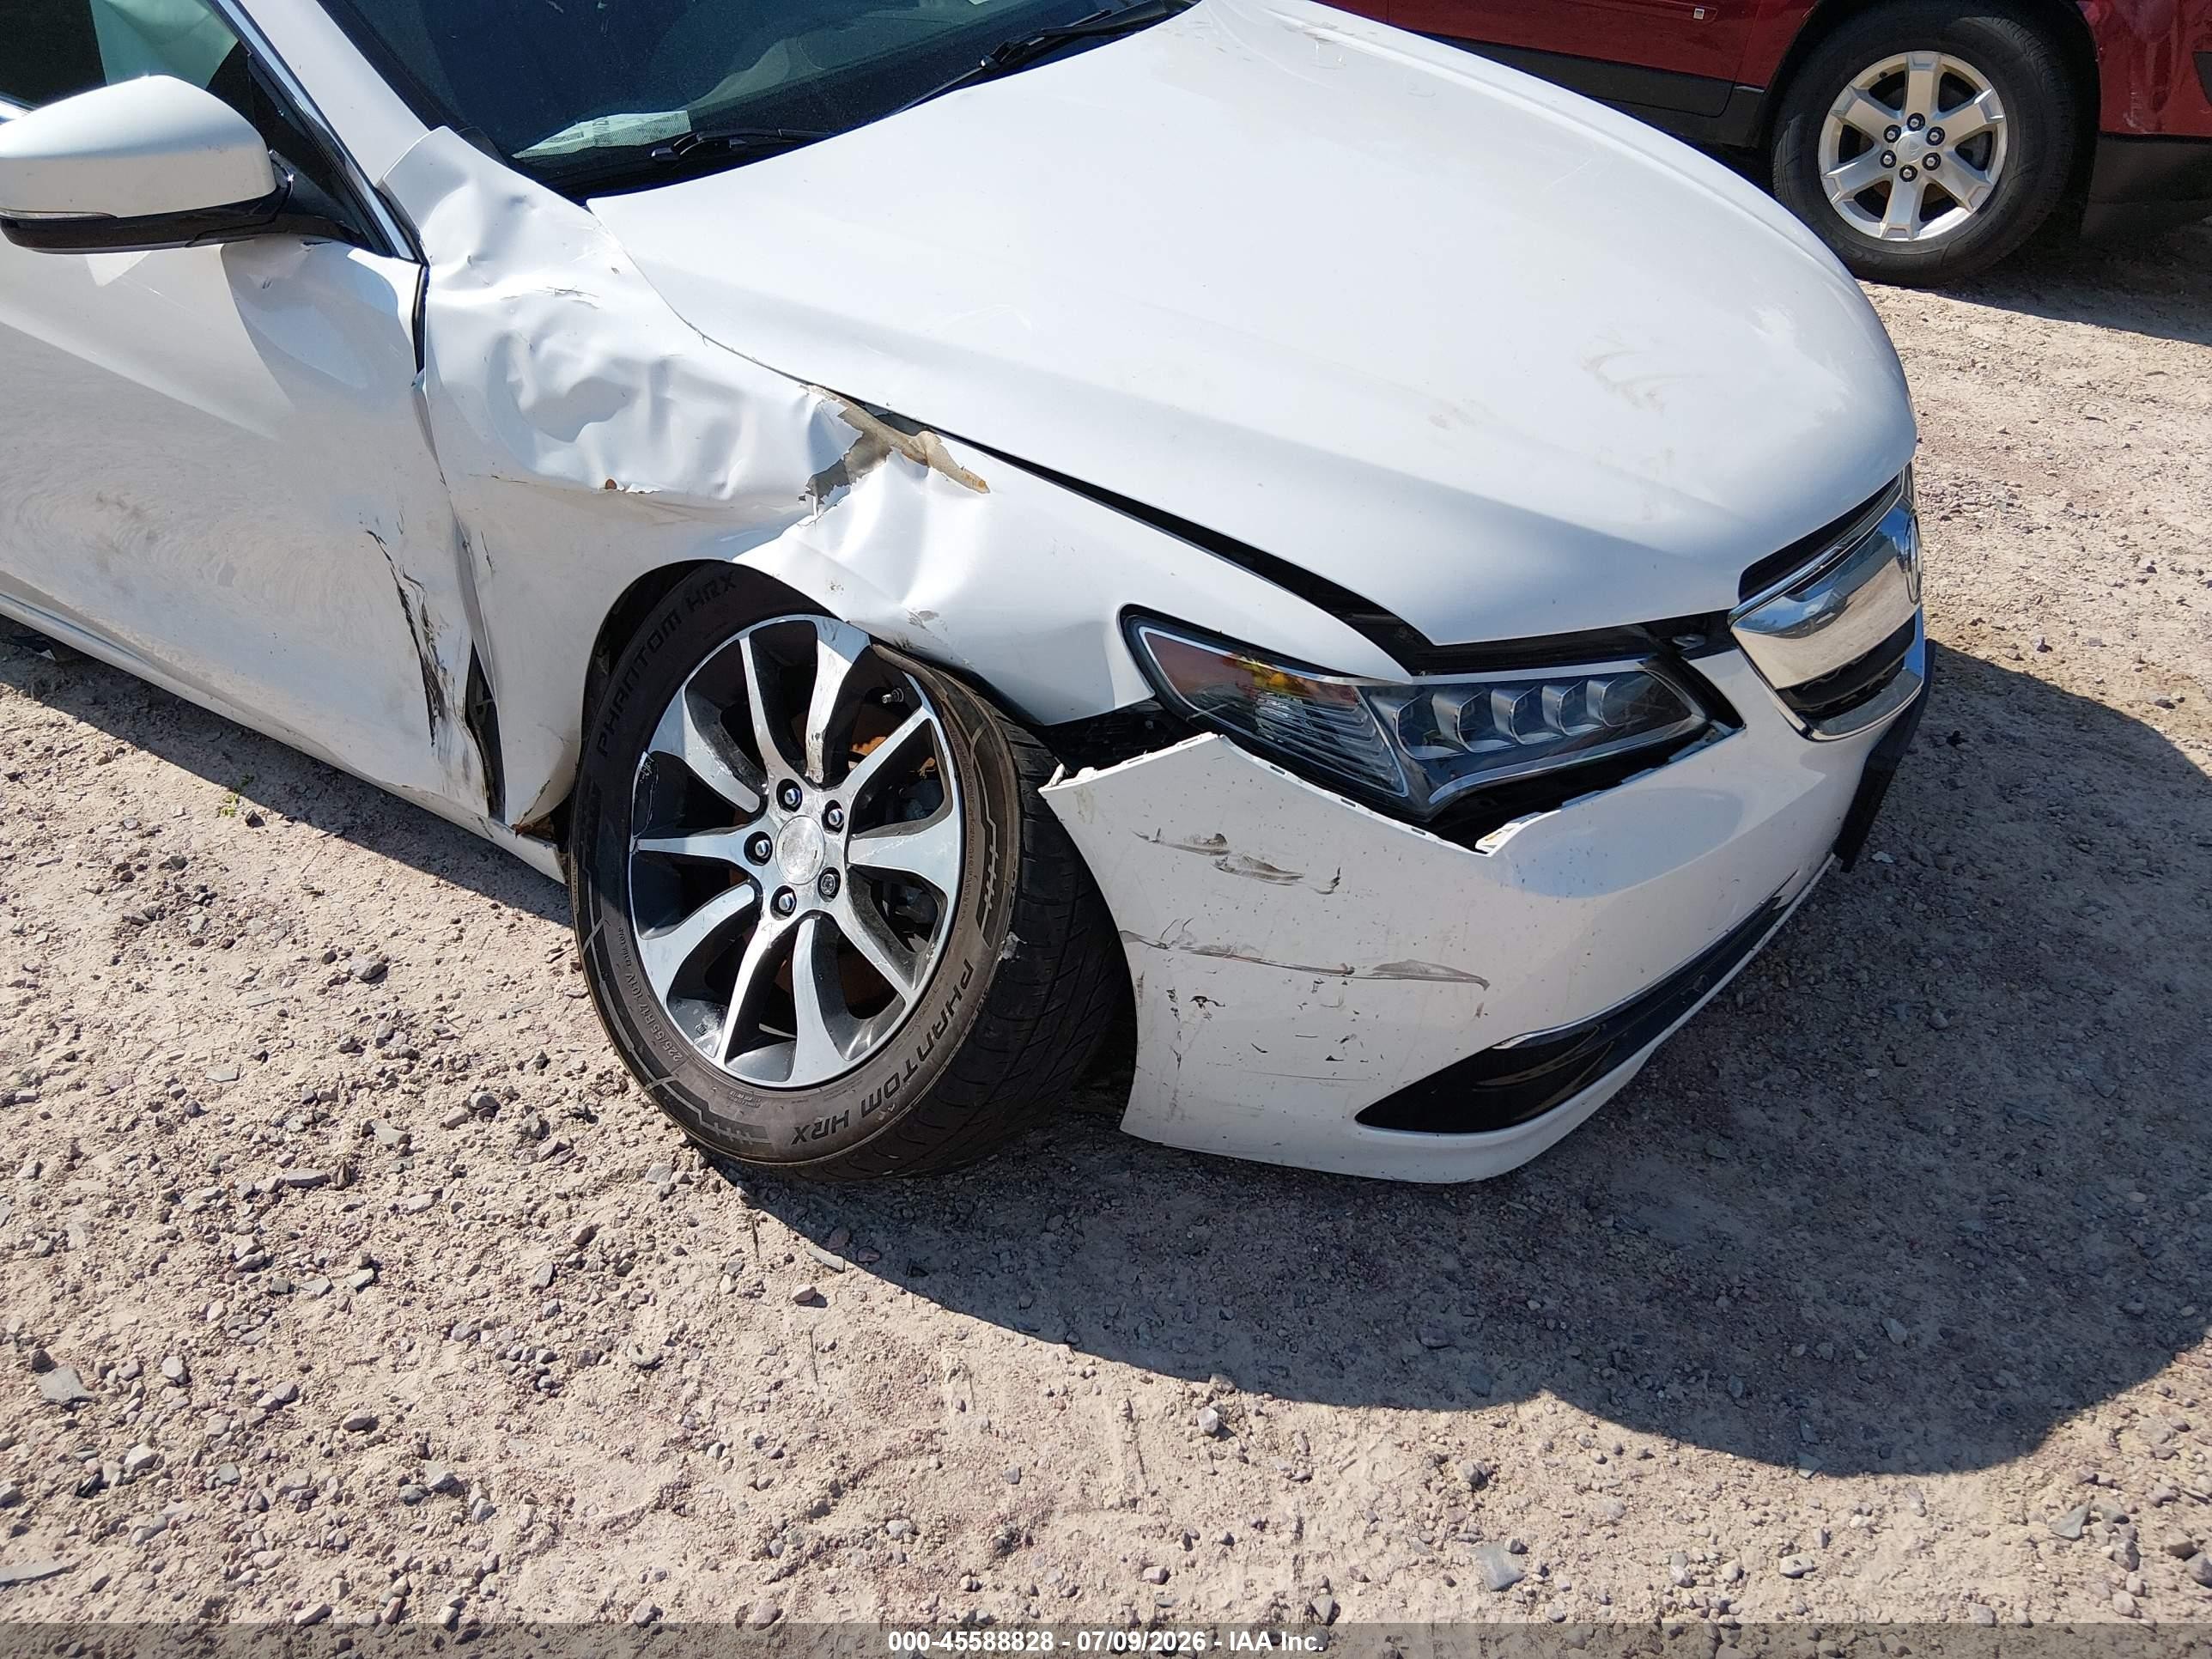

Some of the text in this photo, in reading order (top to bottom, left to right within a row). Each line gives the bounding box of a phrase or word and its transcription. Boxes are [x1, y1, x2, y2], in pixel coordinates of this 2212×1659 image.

[597, 609, 682, 757] PHANTOM
[861, 957, 975, 1118] PHANTOM
[791, 1109, 850, 1145] HRX
